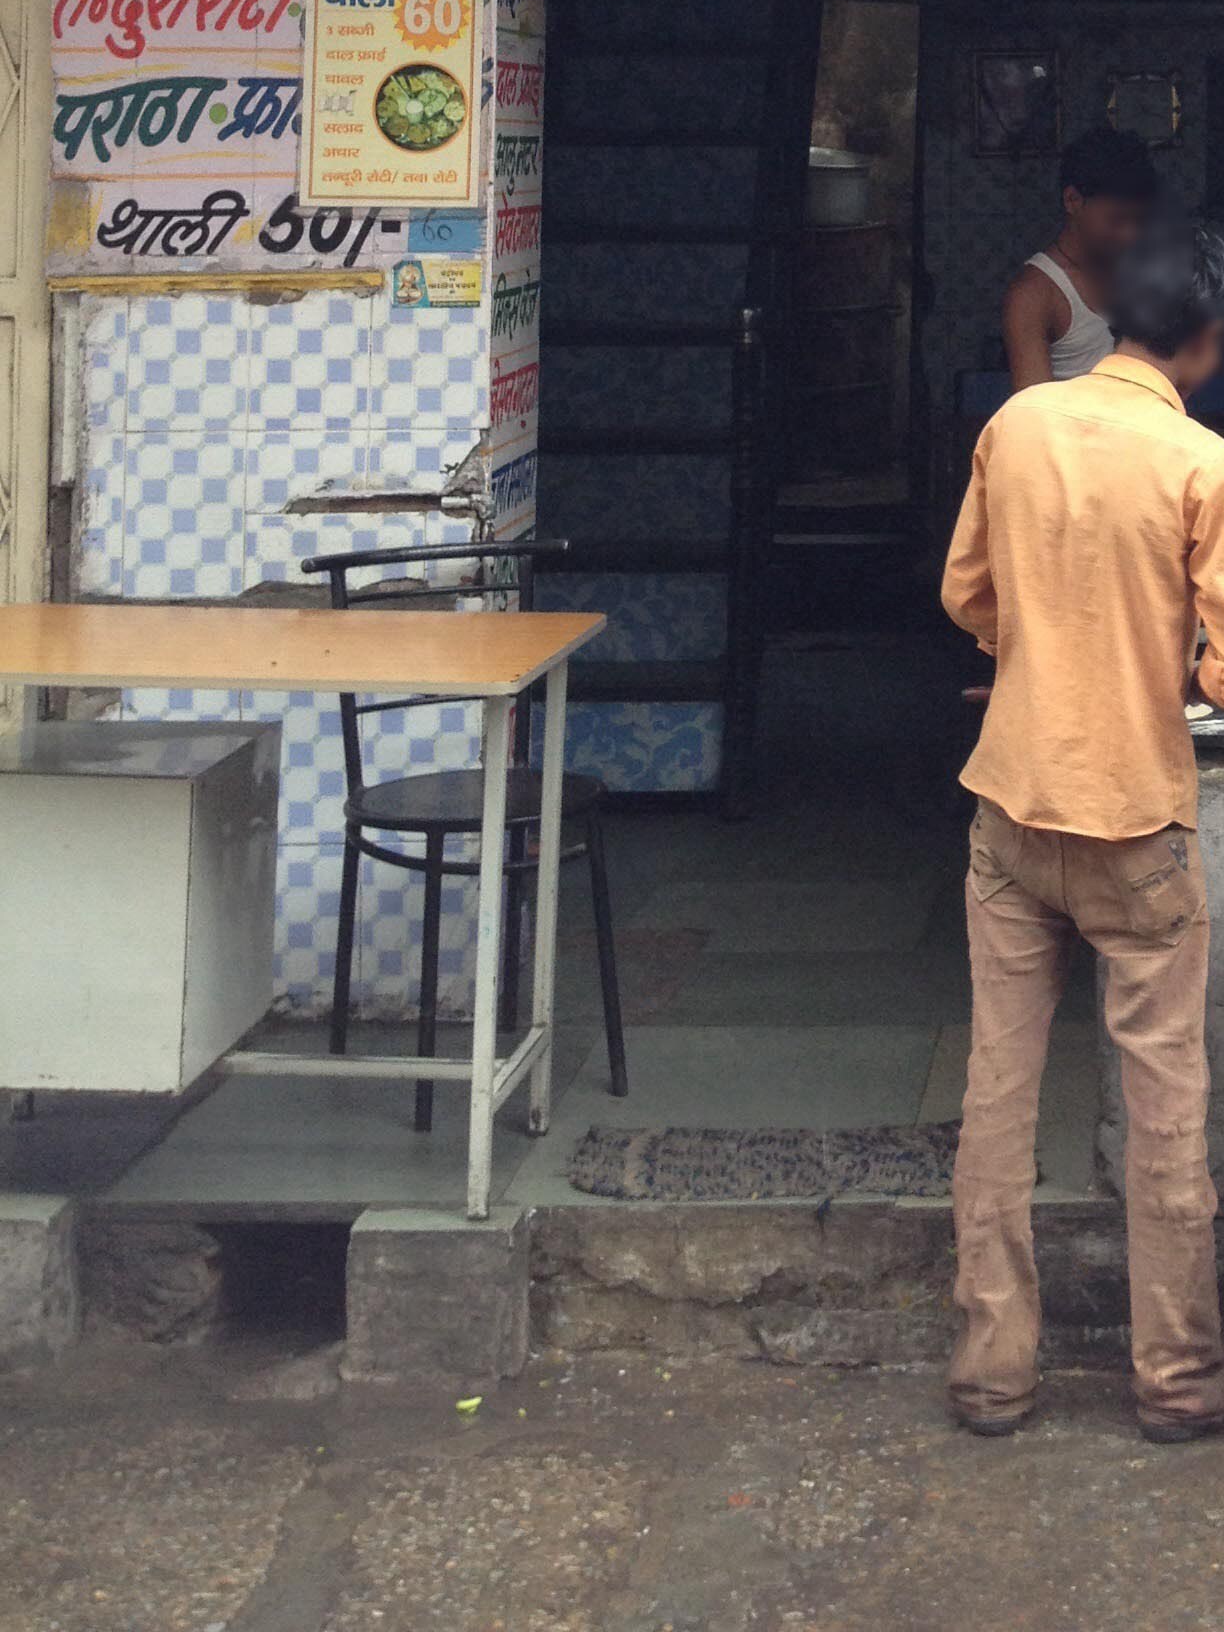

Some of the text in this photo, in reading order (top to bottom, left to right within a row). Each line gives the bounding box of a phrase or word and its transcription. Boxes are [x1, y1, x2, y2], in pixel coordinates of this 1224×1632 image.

[52, 74, 303, 164] पराठा फ्रा
[96, 190, 251, 256] थाली
